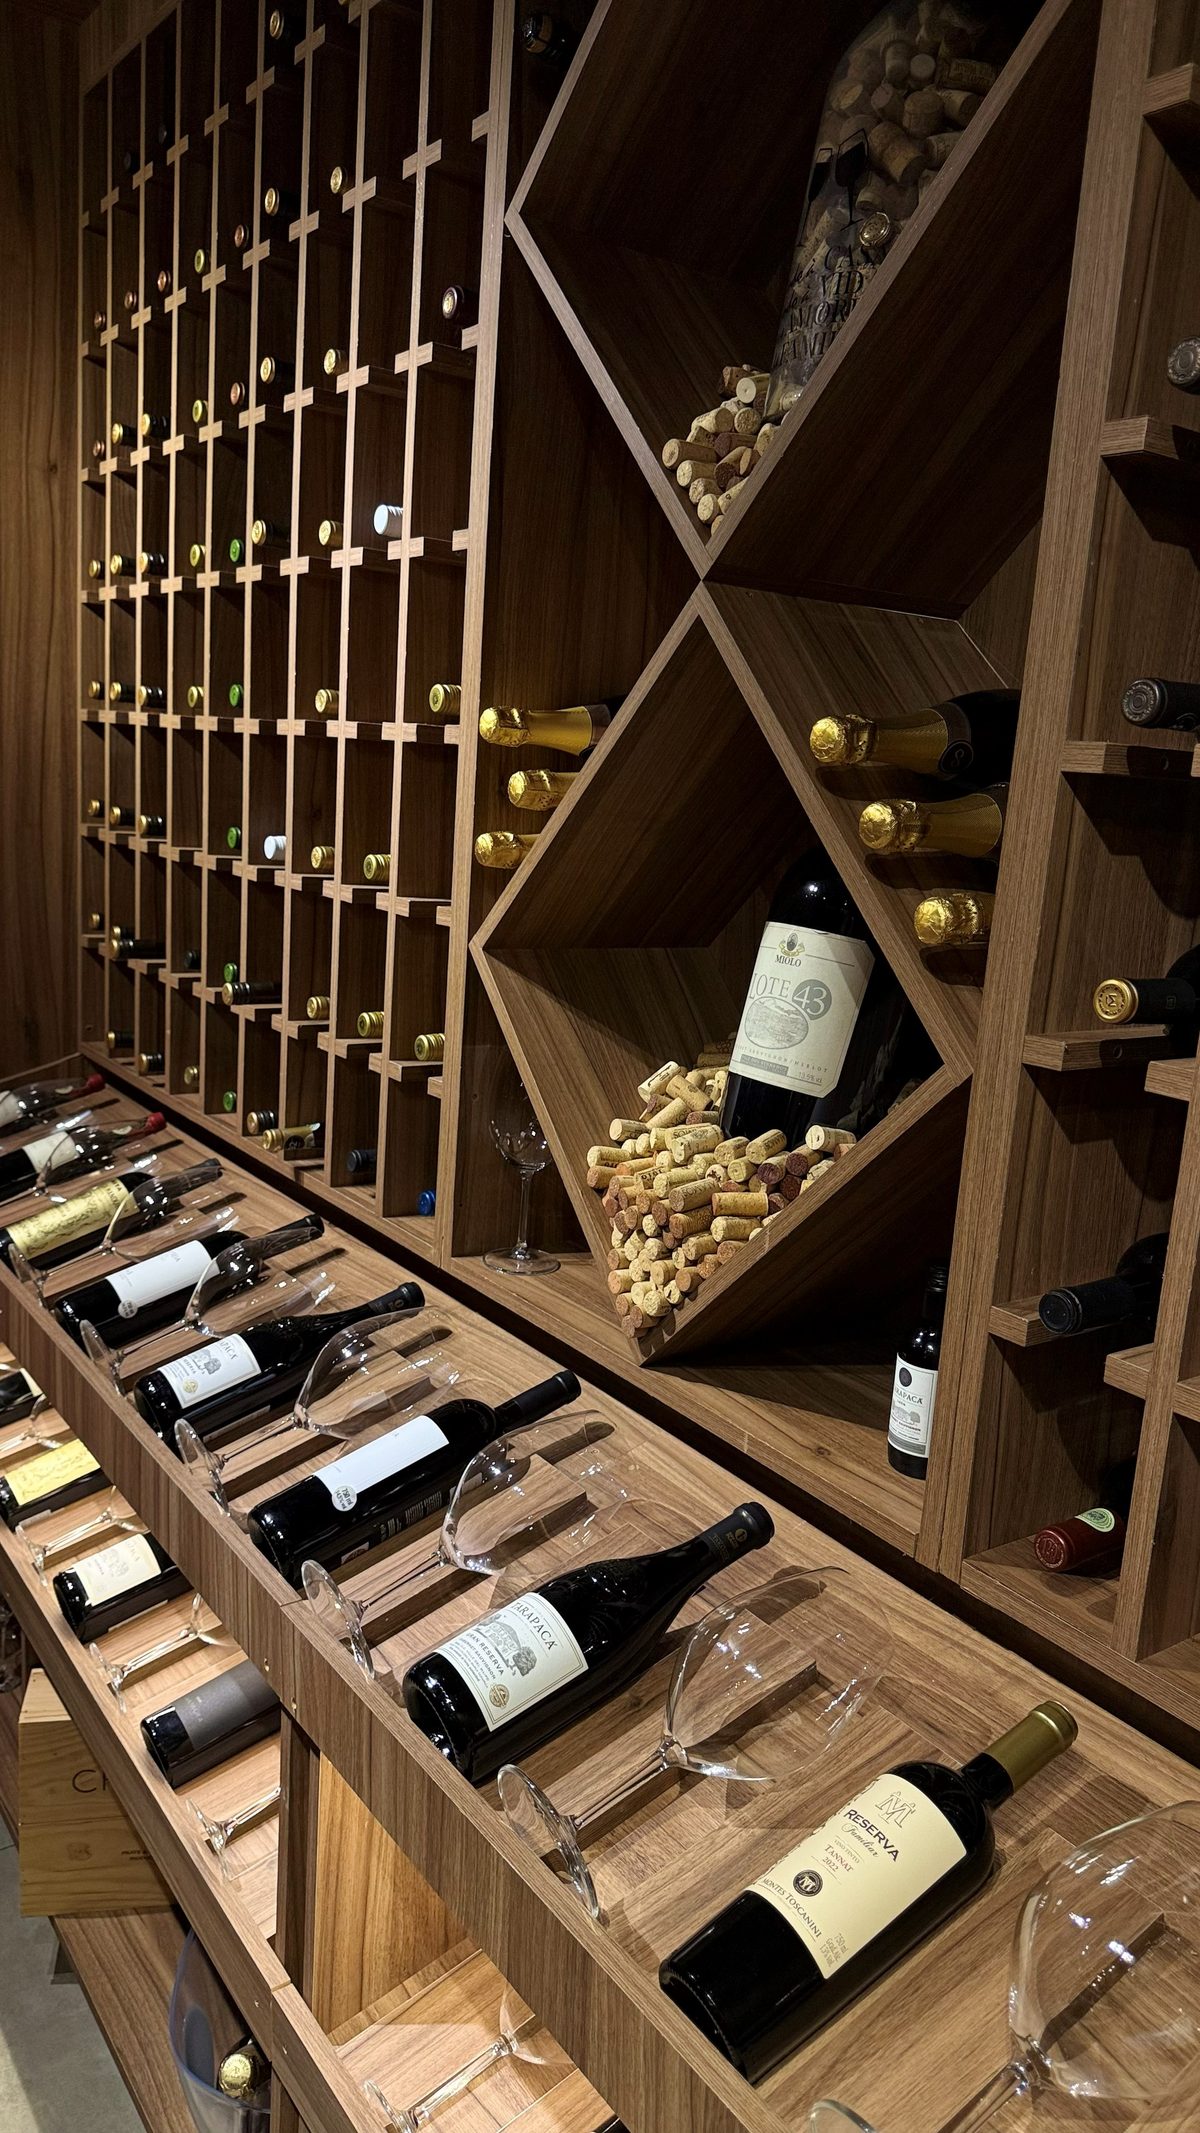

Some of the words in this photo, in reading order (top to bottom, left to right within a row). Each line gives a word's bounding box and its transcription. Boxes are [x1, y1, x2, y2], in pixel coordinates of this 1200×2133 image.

[774, 953, 802, 968] MIOLO
[749, 972, 792, 1000] LOTE
[793, 984, 827, 1016] 43
[510, 1602, 558, 1651] TARAPACÁ
[480, 1642, 504, 1676] RESERVA
[840, 1824, 879, 1859] Familiar
[843, 1809, 900, 1862] RESERVA
[822, 1855, 840, 1873] 2022
[823, 1844, 854, 1874] TANNAT
[762, 1877, 787, 1902] MONTES
[785, 1891, 823, 1939] TOSCANINI
